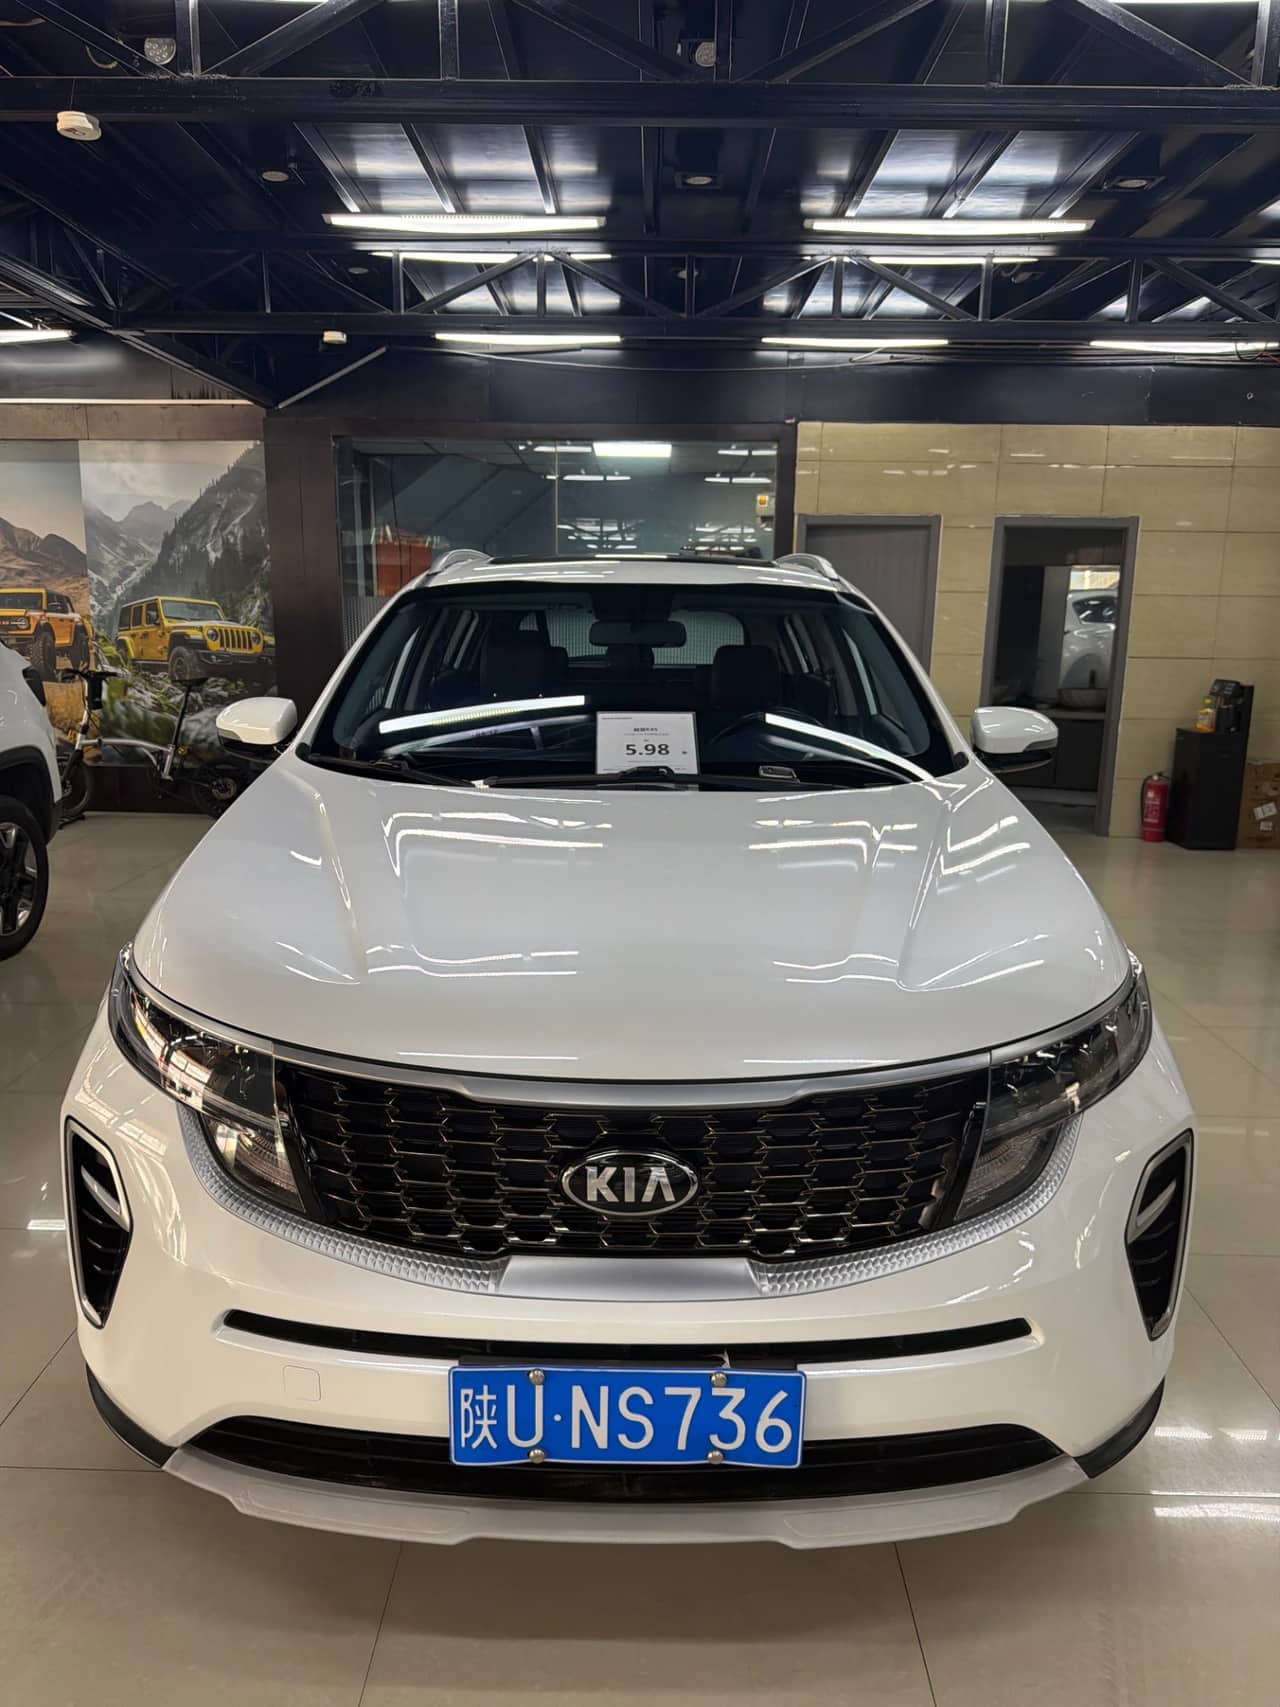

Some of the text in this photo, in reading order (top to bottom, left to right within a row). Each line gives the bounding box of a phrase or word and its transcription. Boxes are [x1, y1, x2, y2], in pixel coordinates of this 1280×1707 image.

[625, 743, 670, 756] 5.98
[585, 1166, 676, 1202] KIA
[460, 1384, 793, 1454] 陕U·NS736
